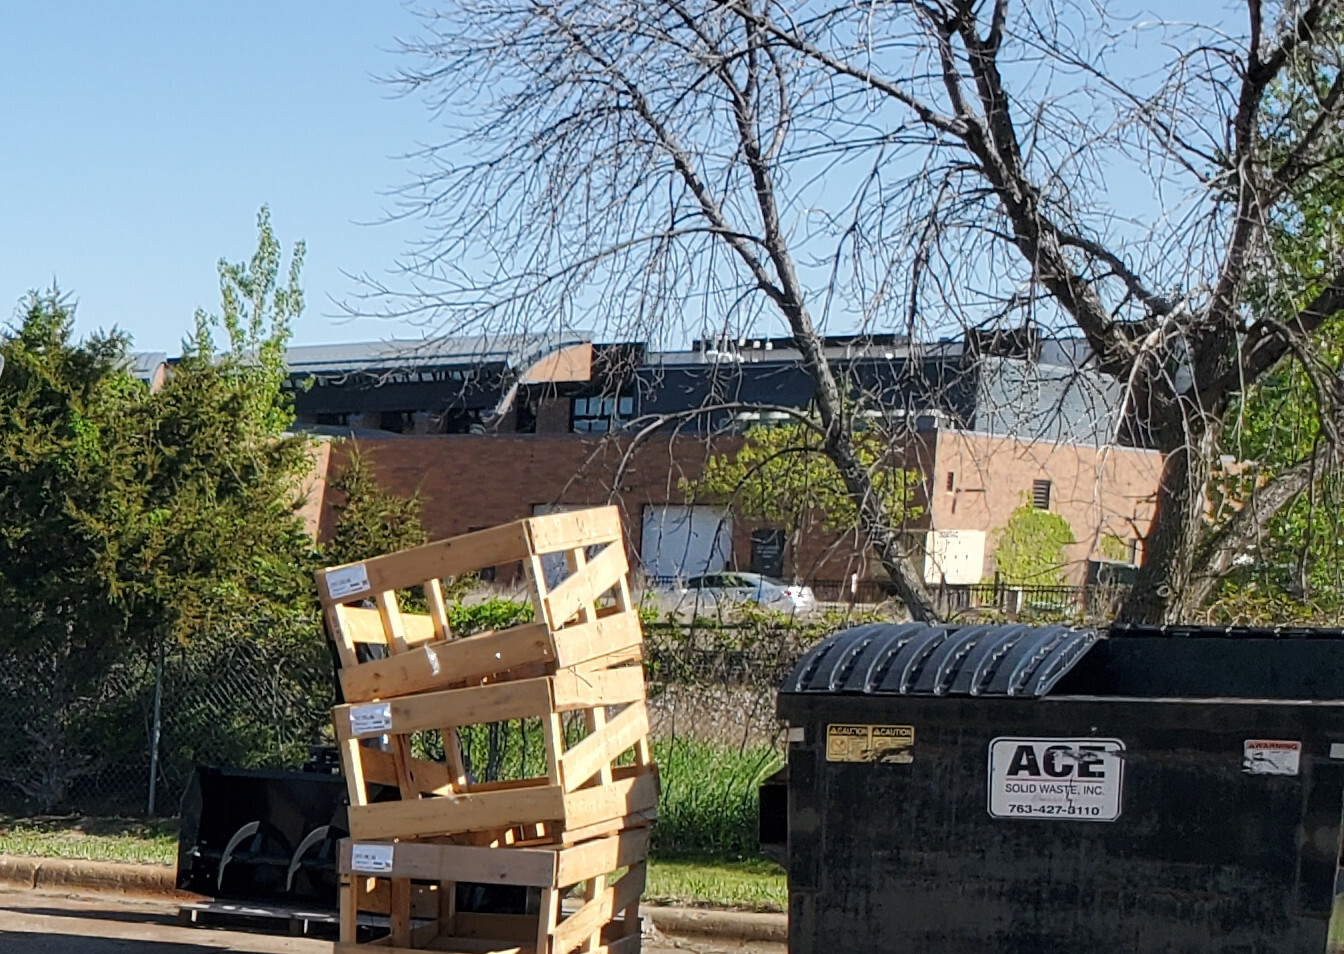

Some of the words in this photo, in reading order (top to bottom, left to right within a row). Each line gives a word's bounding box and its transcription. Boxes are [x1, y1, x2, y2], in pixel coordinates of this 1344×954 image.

[1006, 745, 1106, 778] ACE
[1005, 783, 1037, 794] SOLID
[1039, 784, 1080, 796] WASTE,
[1083, 785, 1105, 796] INC.
